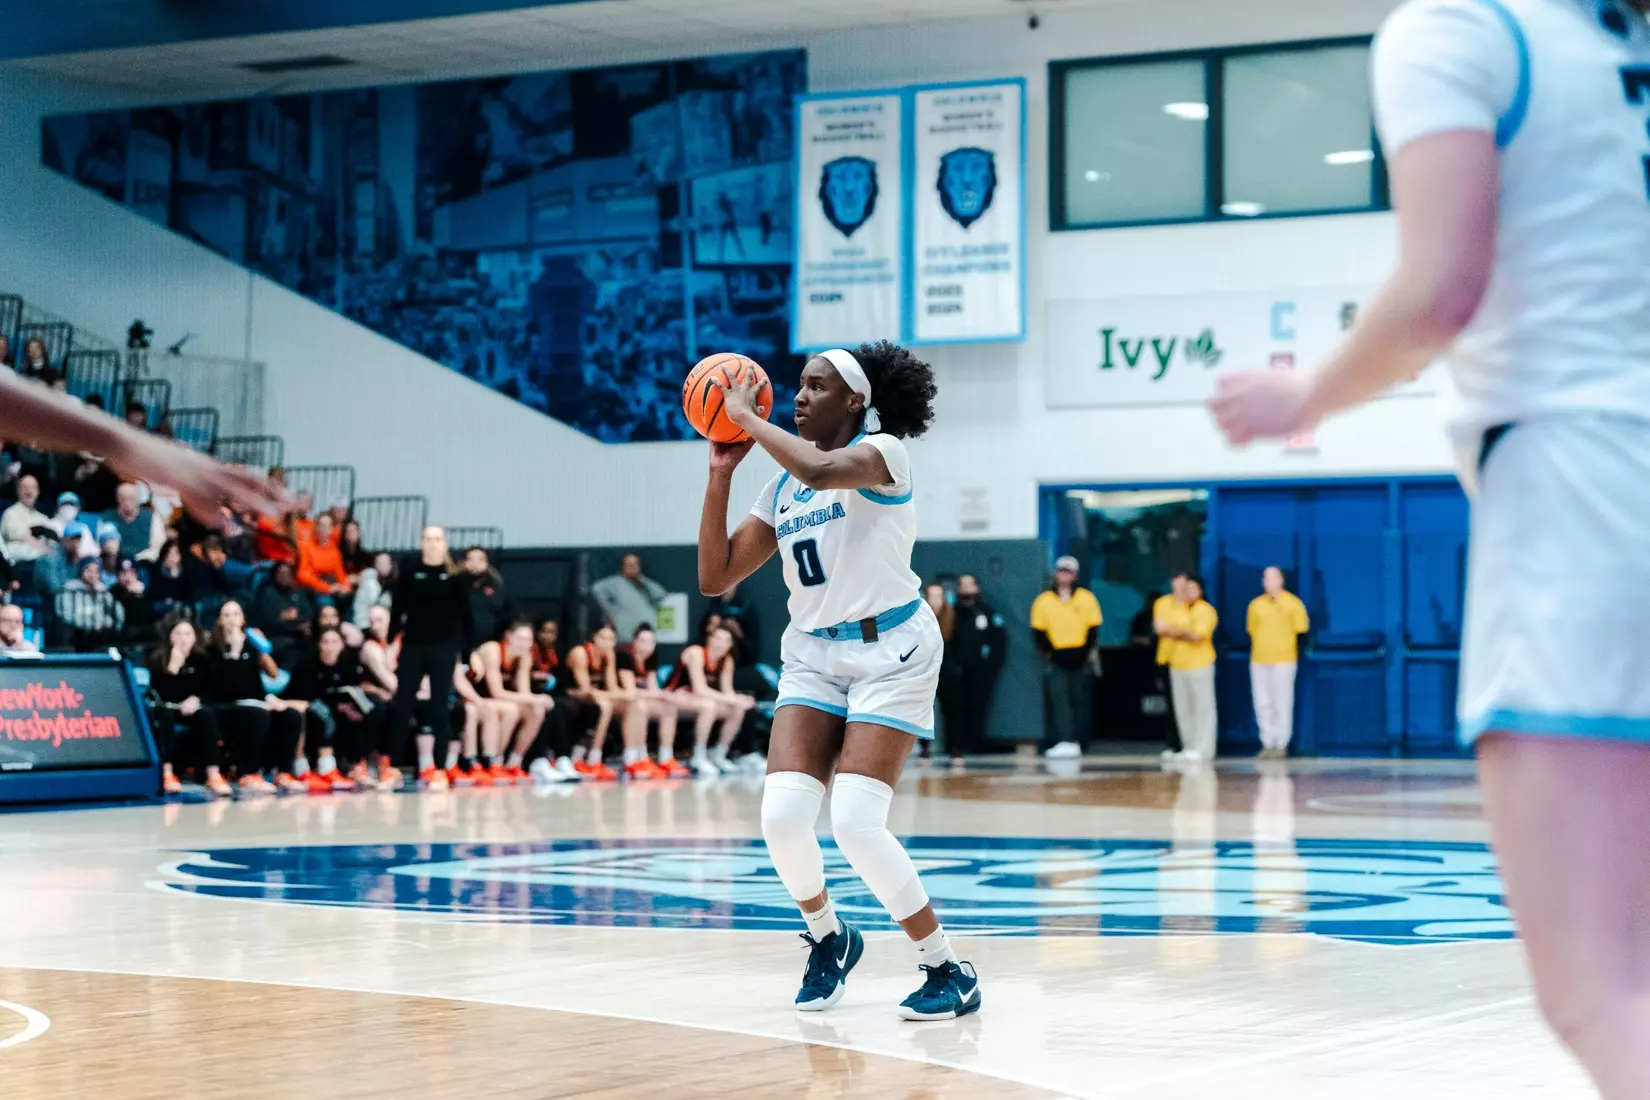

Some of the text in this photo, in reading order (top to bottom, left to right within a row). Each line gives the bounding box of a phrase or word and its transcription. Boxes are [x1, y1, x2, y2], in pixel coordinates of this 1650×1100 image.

[1098, 328, 1177, 382] Ivy
[793, 537, 826, 587] 0
[0, 680, 84, 710] ewYork-
